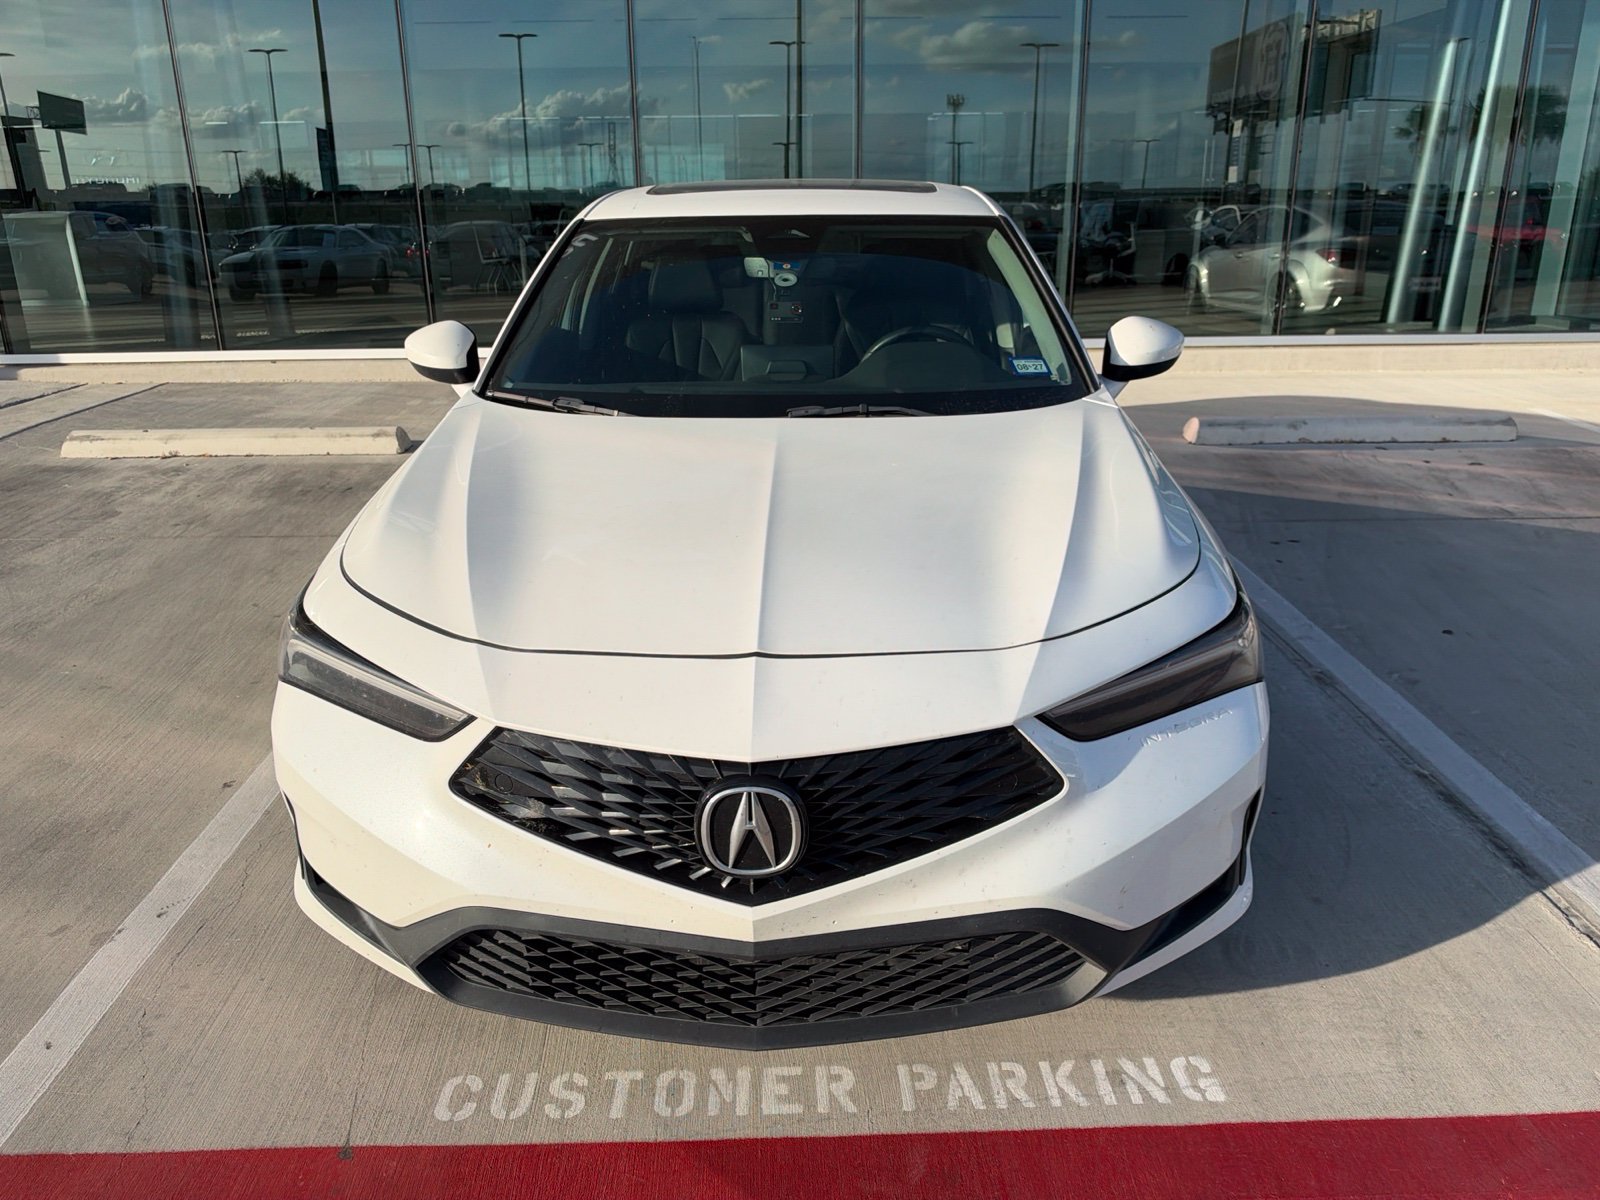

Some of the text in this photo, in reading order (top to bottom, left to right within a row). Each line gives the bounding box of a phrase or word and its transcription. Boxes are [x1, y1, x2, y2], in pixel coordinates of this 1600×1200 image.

[1140, 708, 1233, 747] INTEGRA
[433, 1055, 1226, 1121] CUSTOMER PARKING
